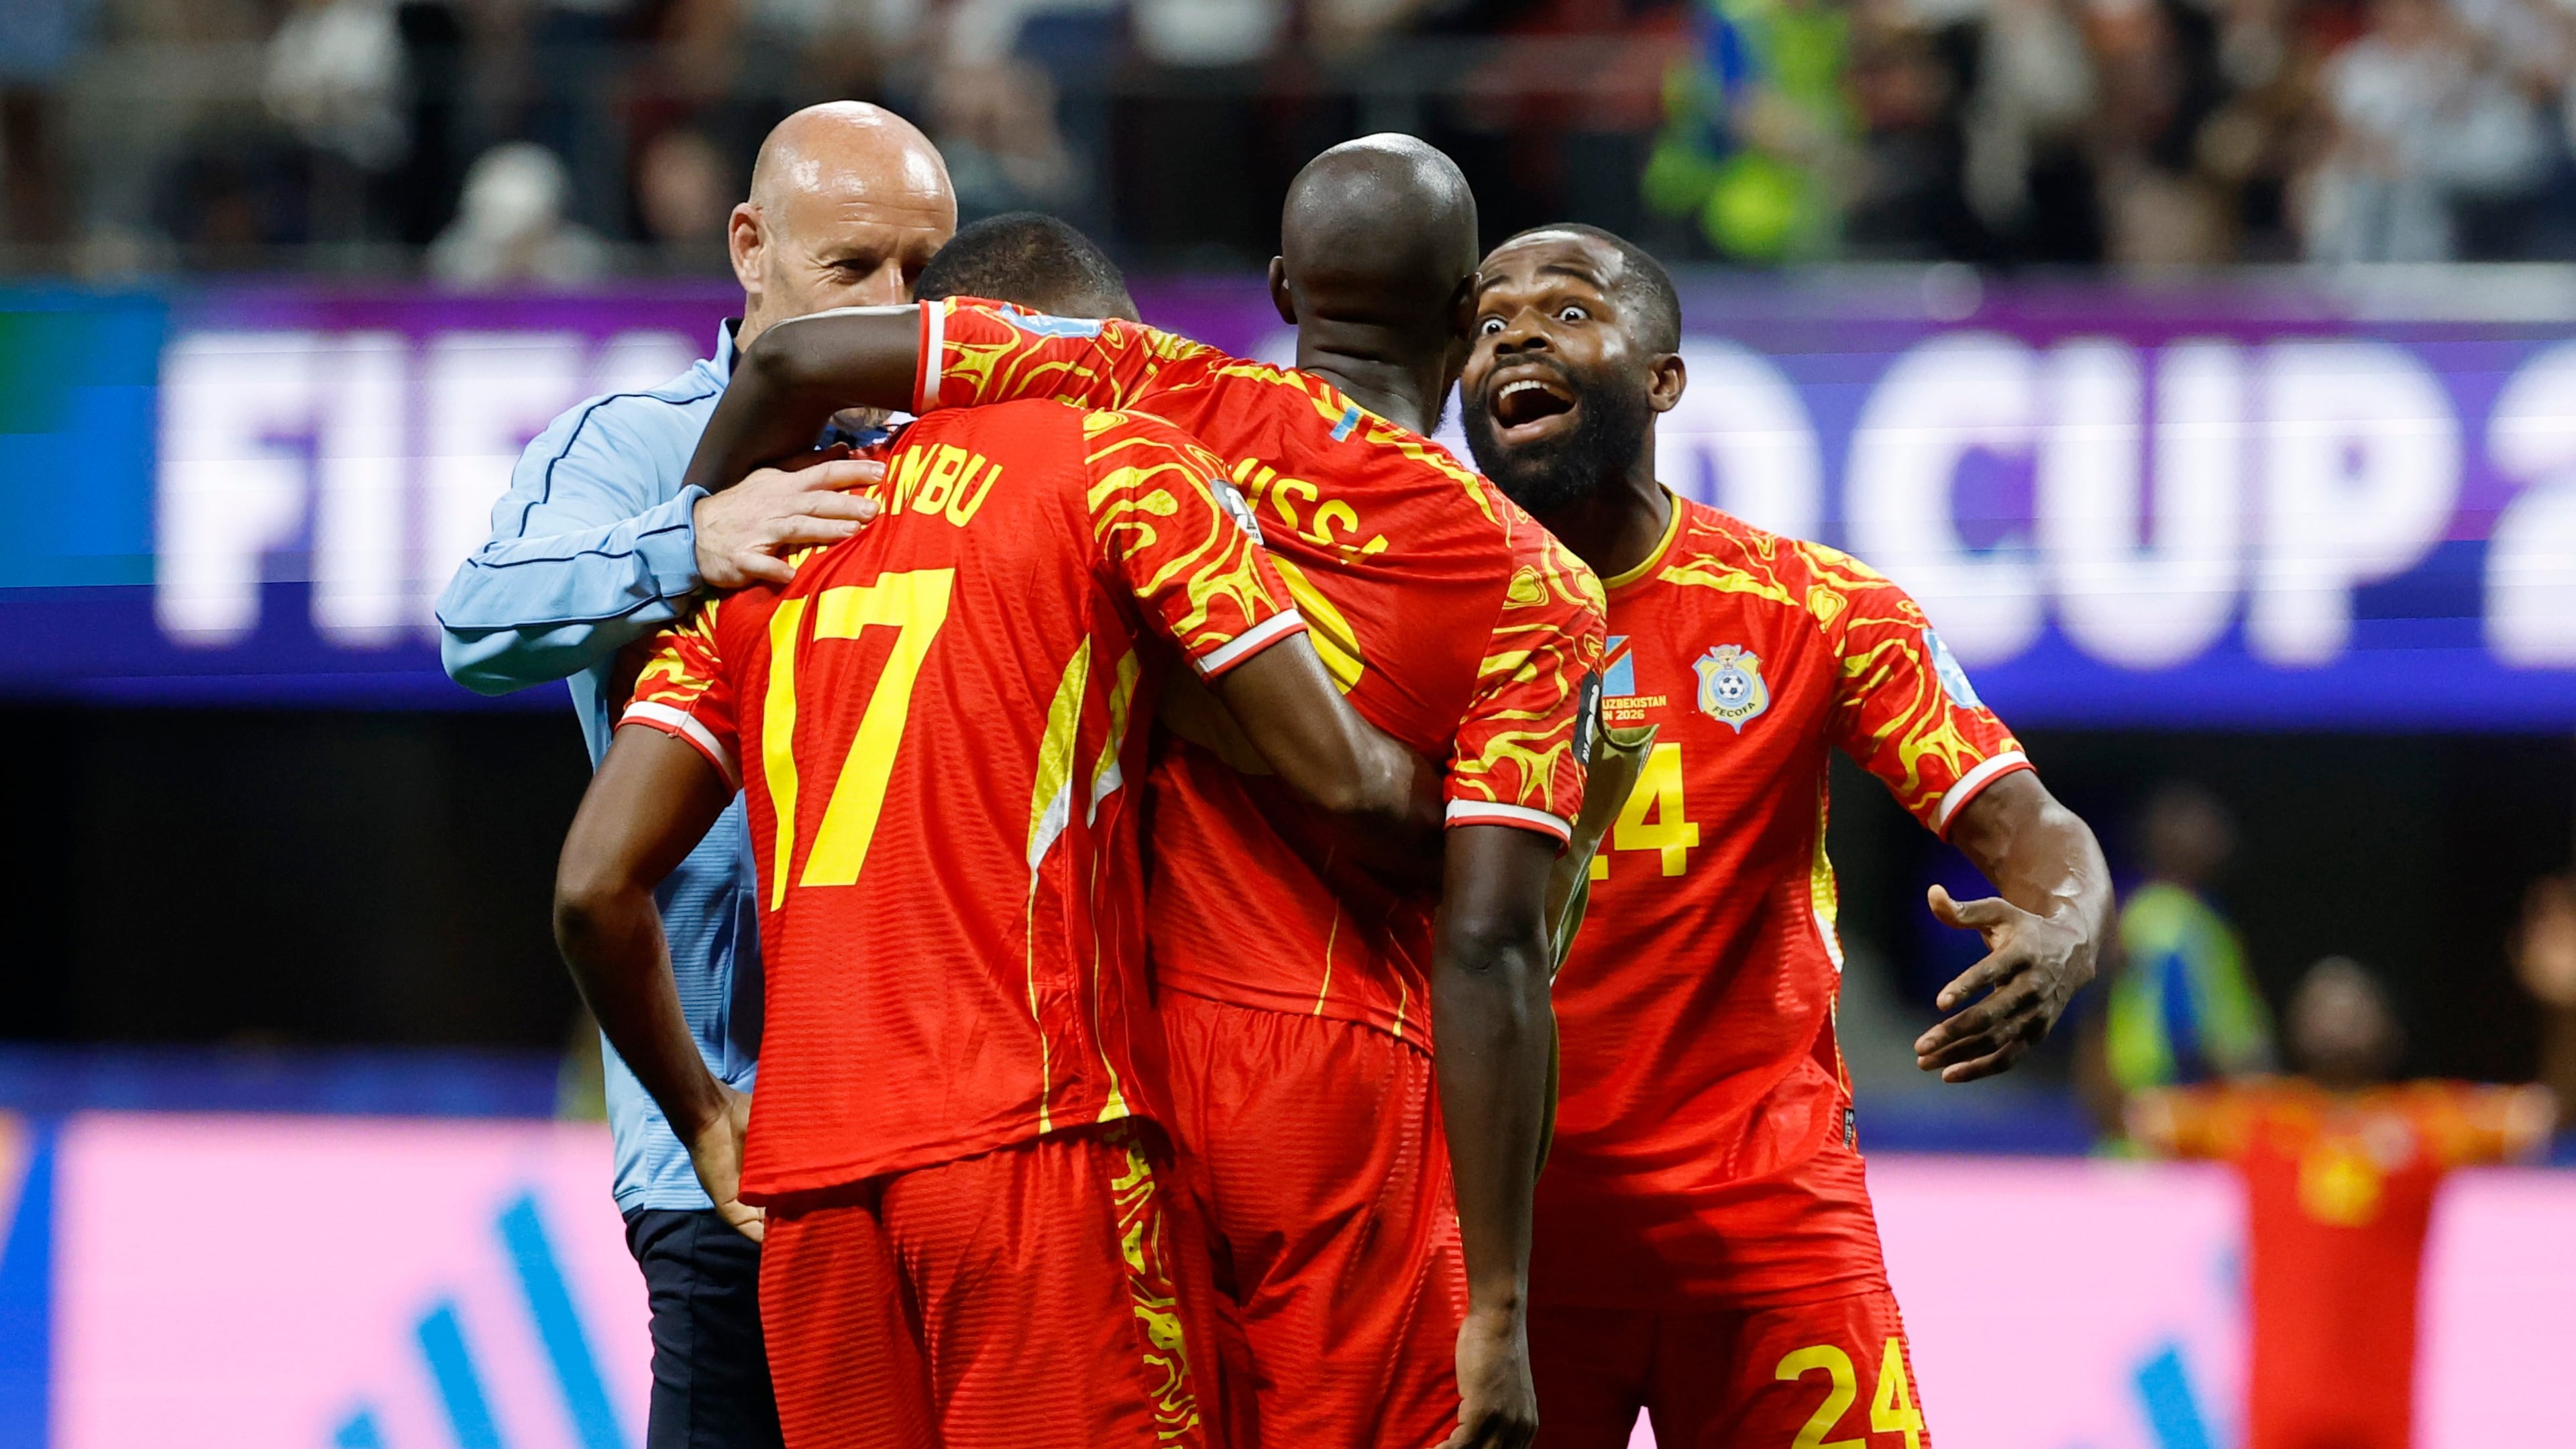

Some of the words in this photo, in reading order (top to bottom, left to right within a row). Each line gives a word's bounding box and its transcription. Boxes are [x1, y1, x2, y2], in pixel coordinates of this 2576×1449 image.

[154, 330, 704, 645] FIF
[1845, 330, 2463, 667] CUP
[762, 568, 955, 912] 17
[1602, 695, 1666, 710] UZBEKISTAN
[1615, 709, 1645, 720] 2026
[1712, 702, 1756, 718] FECOFA
[1590, 742, 1699, 880] 4
[1775, 1336, 1924, 1449] 24
